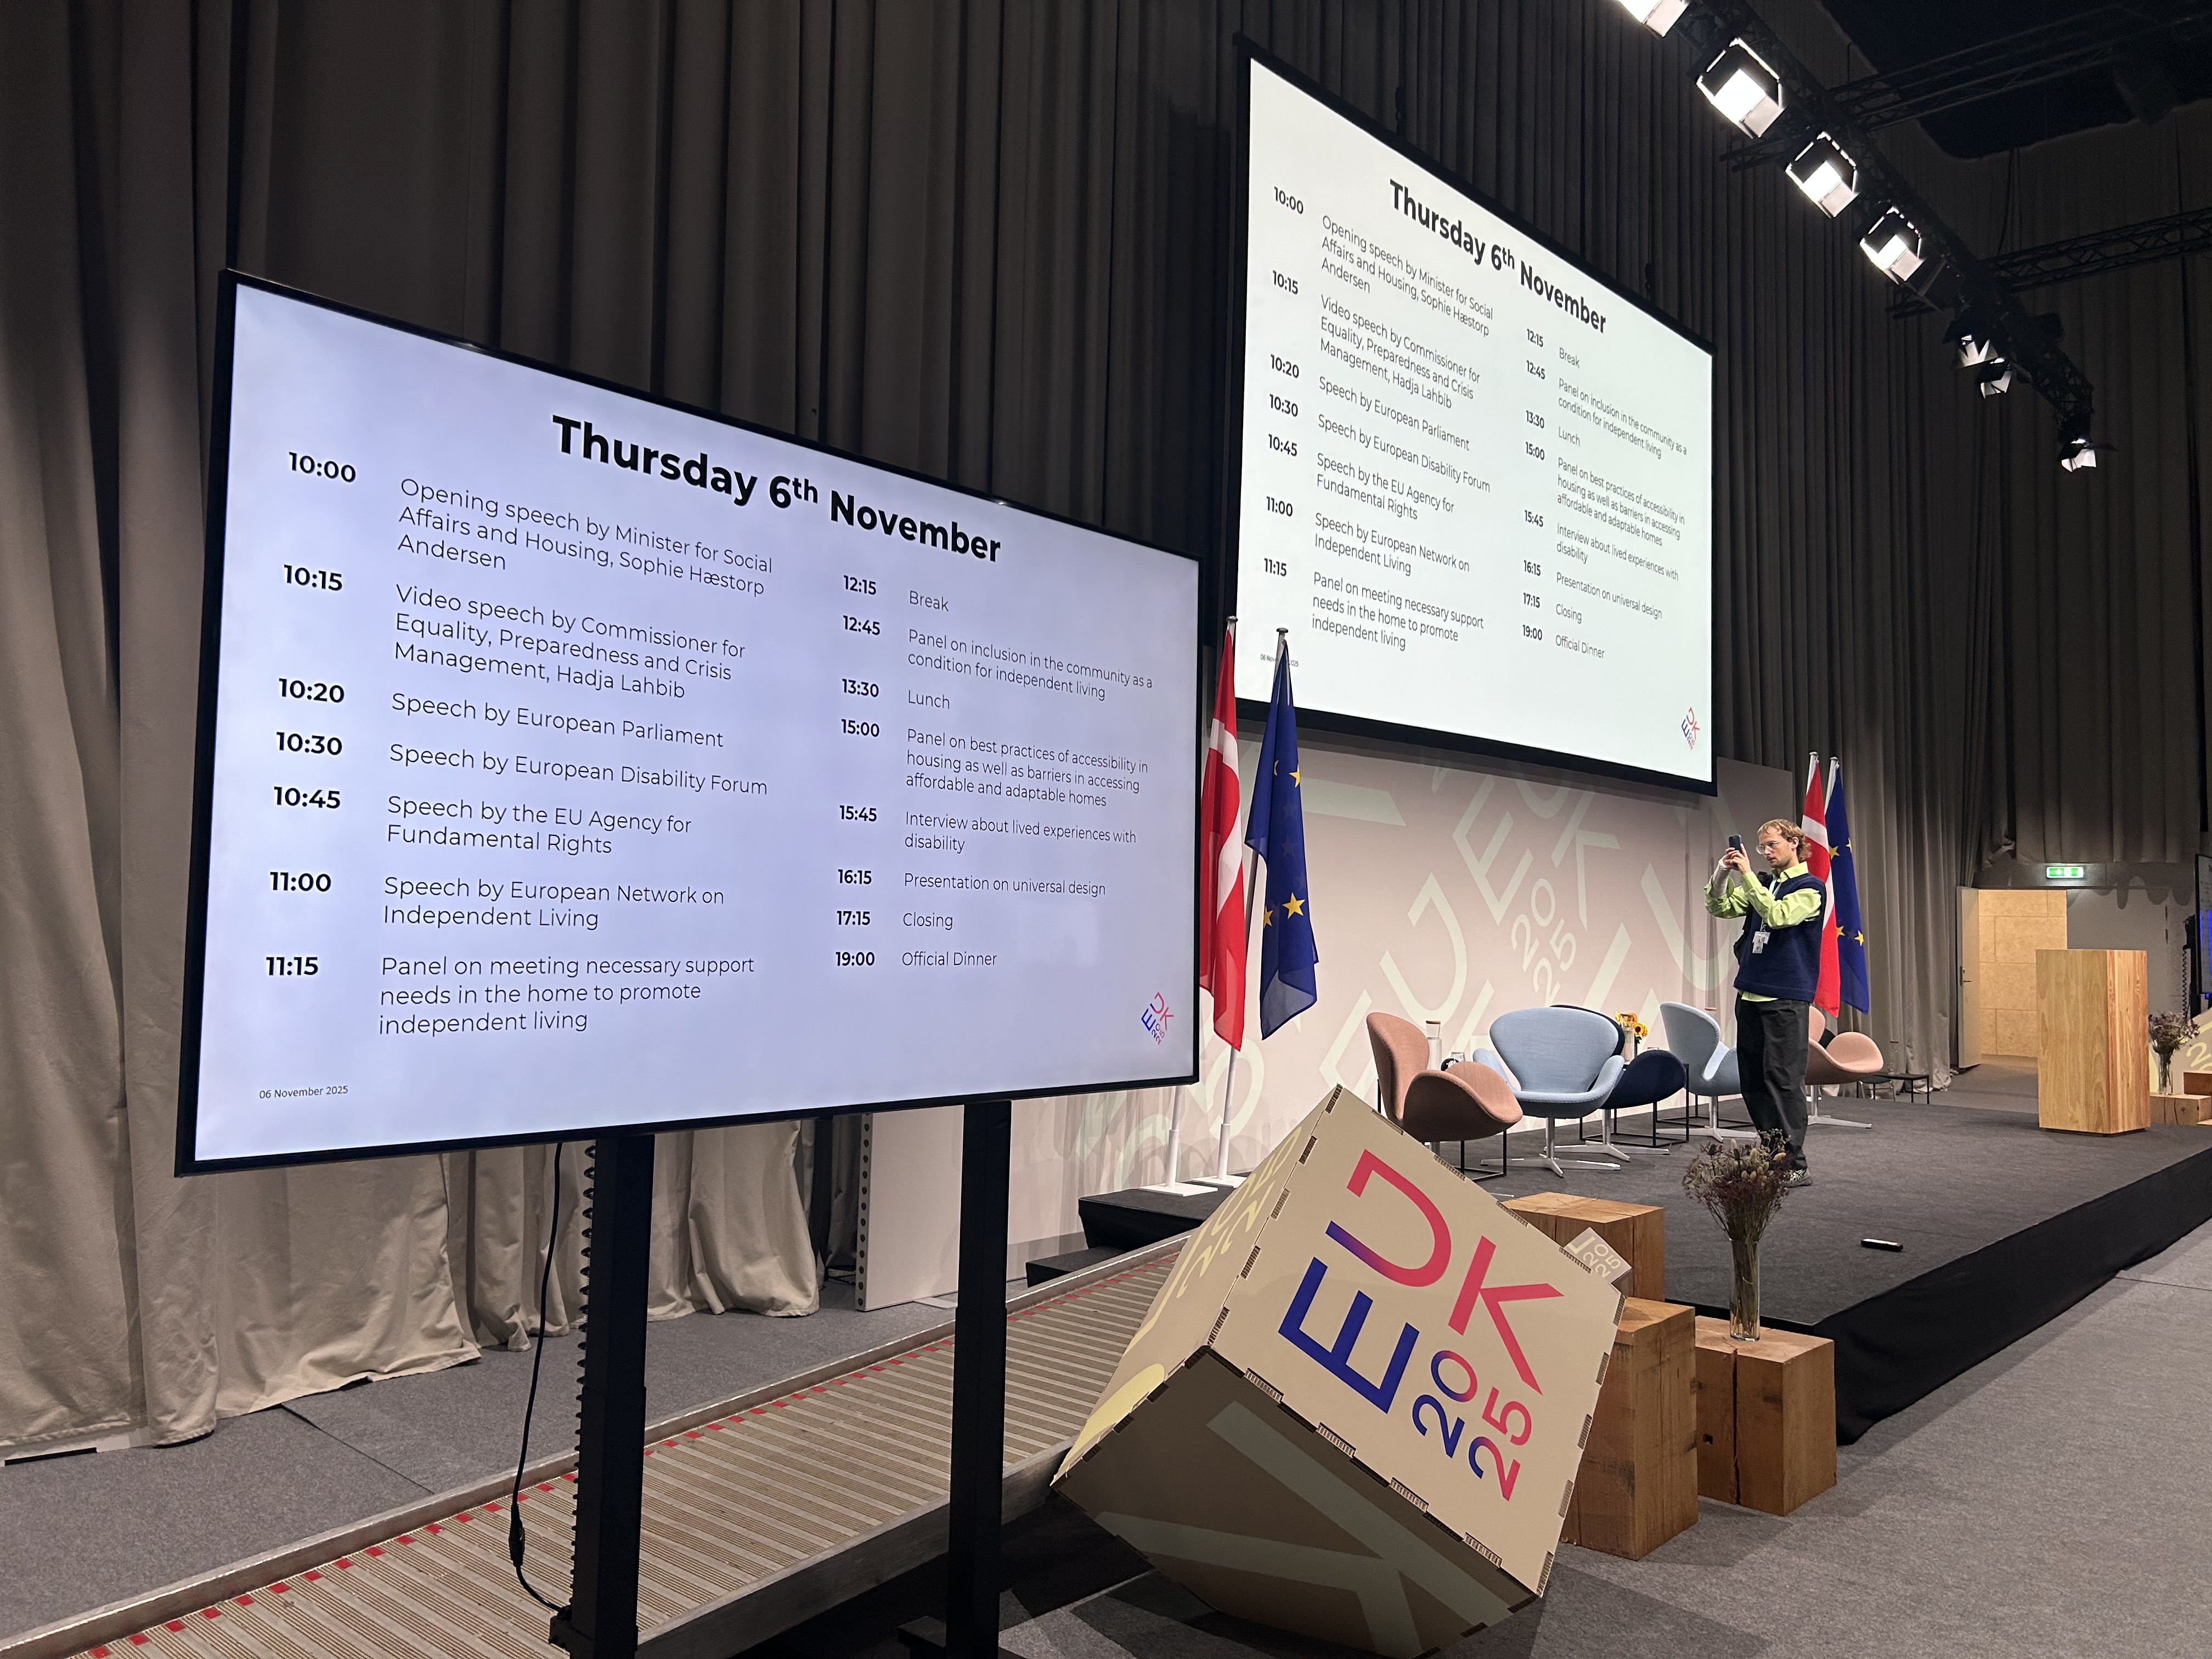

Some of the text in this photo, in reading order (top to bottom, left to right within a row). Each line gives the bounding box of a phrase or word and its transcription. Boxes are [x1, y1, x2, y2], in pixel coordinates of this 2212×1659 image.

[1274, 186, 1304, 215] 10:00
[1390, 179, 1486, 266] Thursday
[1521, 260, 1606, 334] November
[1272, 270, 1299, 295] 10:15
[1527, 328, 1544, 348] 12:15
[1271, 354, 1299, 379] 10:20
[1526, 360, 1545, 380] 12:45
[1559, 347, 1580, 369] Break
[1269, 393, 1298, 417] 10:30
[1559, 377, 1687, 455] Panel on inclusion in the community as a
[1526, 410, 1545, 429] 13:30
[1558, 397, 1661, 460] condition for independent living
[1268, 433, 1297, 456] 10:45
[1558, 426, 1581, 447] Lunch
[1525, 441, 1545, 461] 15:00
[289, 452, 356, 483] 10:00
[552, 415, 758, 506] Thursday
[831, 490, 1001, 562] November
[1558, 457, 1685, 524] Panel on best practices of accessibility in
[1266, 496, 1293, 517] 11:00
[1524, 510, 1544, 527] 15:45
[401, 478, 772, 573] Opening speech by Minister for Social
[398, 506, 764, 597] Affairs and Housing, Sophie Hæstorp
[398, 534, 505, 569] Andersen
[1556, 540, 1588, 565] disability
[1557, 523, 1679, 581] Interview about lived experiences with
[284, 565, 342, 591] 10:15
[1264, 557, 1287, 577] 11:15
[1523, 560, 1541, 577] 16:15
[843, 574, 876, 595] 12:15
[910, 590, 949, 612] Break
[1314, 572, 1484, 629] Panel on meeting necessary support
[1523, 592, 1540, 608] 17:15
[396, 584, 746, 658] Video speech by Commissioner for
[843, 615, 880, 636] 12:45
[1313, 596, 1458, 641] needs in the home to promote
[1556, 603, 1582, 624] Closing
[1312, 613, 1406, 652] independent living
[1522, 624, 1543, 641] 19:00
[397, 613, 731, 680] Equality, Preparedness and Crisis
[1555, 634, 1605, 658] Official Dinner
[396, 642, 684, 698] Management, Hadja Lahbib
[279, 678, 345, 703] 10:20
[842, 678, 879, 697] 13:30
[909, 690, 950, 709] Lunch
[392, 693, 723, 747] Speech by European Parliament
[841, 719, 879, 737] 15:00
[276, 732, 342, 755] 10:30
[390, 744, 767, 795] Speech by European Disability Forum
[274, 786, 340, 809] 10:45
[270, 871, 331, 892] 11:00
[838, 869, 872, 884] 16:15
[905, 873, 1105, 898] Presentation on universal design
[385, 877, 724, 904] Speech by European Network on
[385, 905, 598, 930] Independent Living
[837, 911, 871, 926] 17:15
[903, 912, 953, 930] Closing
[266, 956, 318, 975] 11:15
[836, 951, 875, 966] 19:00
[902, 951, 997, 966] Official Dinner
[259, 1086, 348, 1098] 06 November 2025
[1412, 1350, 1478, 1458] 20
[1468, 1386, 1532, 1502] 25
